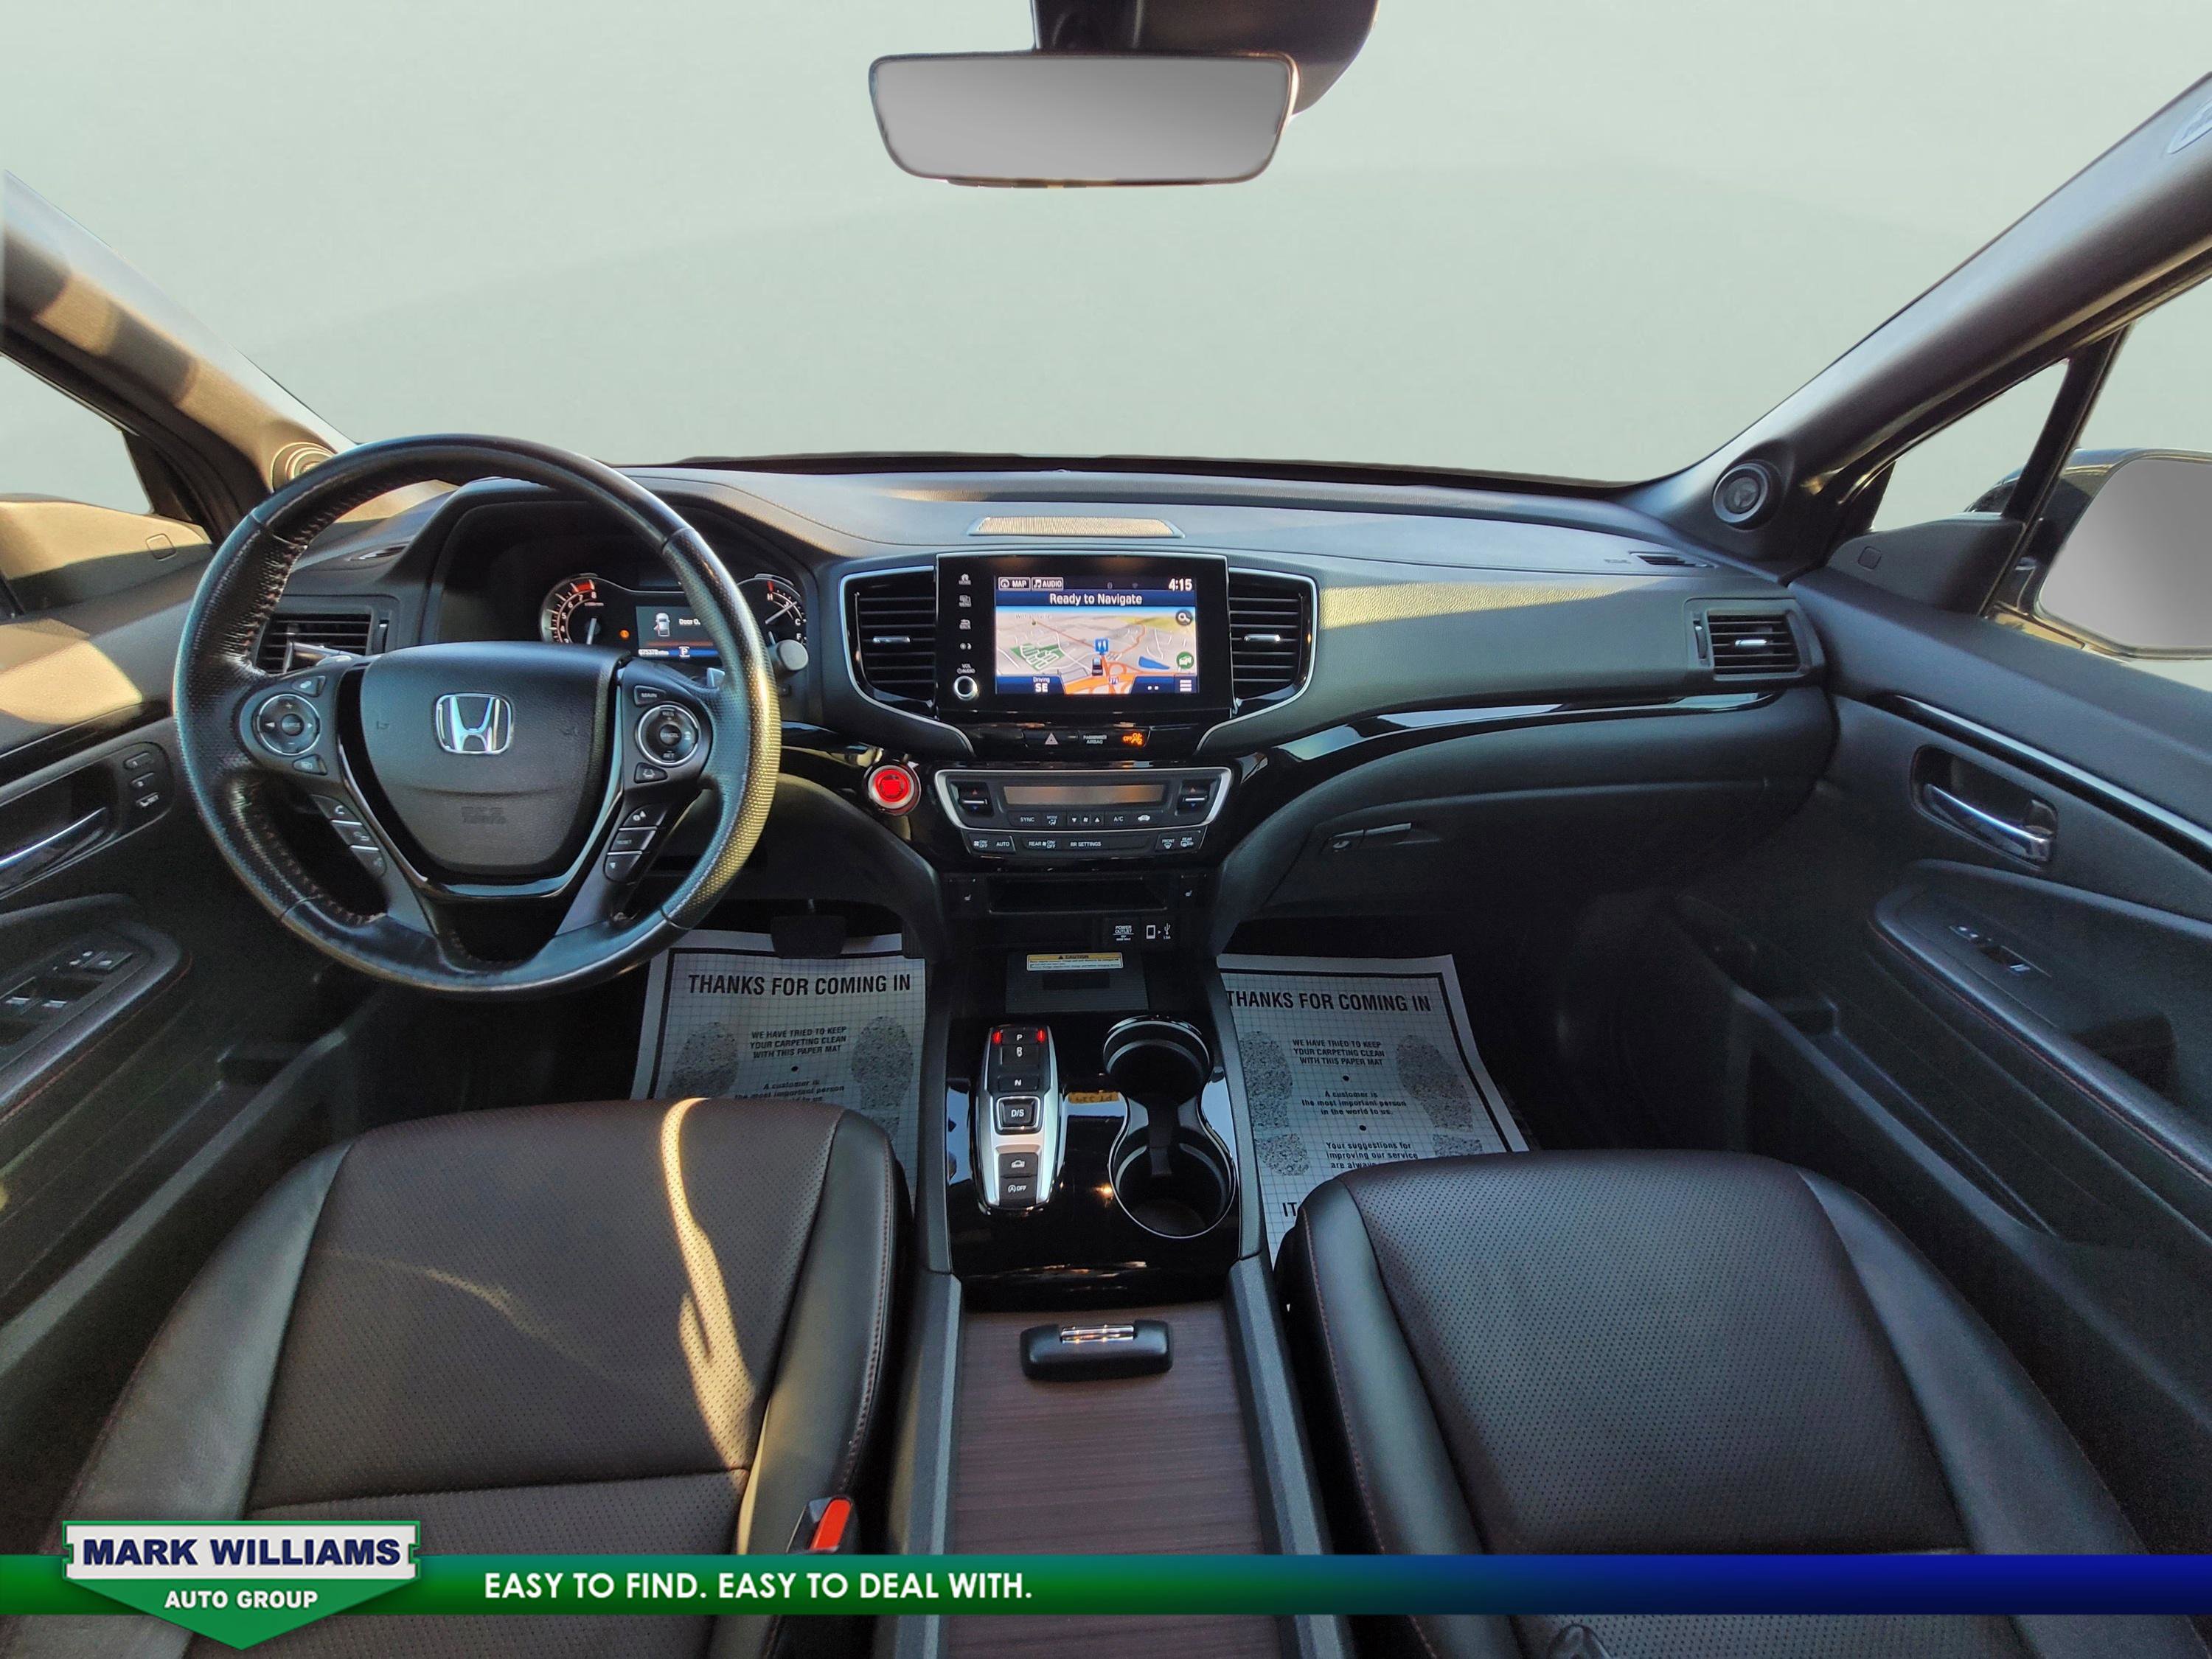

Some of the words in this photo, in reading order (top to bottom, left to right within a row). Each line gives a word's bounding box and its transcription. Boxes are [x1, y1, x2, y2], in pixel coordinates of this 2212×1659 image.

[1169, 578, 1192, 591] 4:15
[1049, 593, 1081, 606] Ready
[1084, 594, 1095, 605] to
[1098, 593, 1142, 606] Navigate
[1035, 683, 1048, 692] SE
[688, 974, 765, 995] THANKS
[771, 977, 809, 995] FOR
[815, 975, 887, 995] COMING
[894, 973, 911, 992] IN
[1227, 990, 1294, 1009] THANKS
[1298, 993, 1334, 1010] FOR
[1339, 994, 1408, 1011] COMING
[1413, 995, 1431, 1012] IN
[752, 1031, 765, 1039] WE
[766, 1030, 787, 1038] HAVE
[790, 1029, 812, 1037] TRIED
[827, 1026, 847, 1034] KEEP
[749, 1041, 772, 1049] YOUR
[774, 1037, 819, 1048] CARPETING
[821, 1035, 846, 1044] CLEAN
[1329, 1040, 1349, 1048] TRIED
[777, 1048, 795, 1057] THIS
[797, 1046, 822, 1055] PAPER
[824, 1044, 841, 1052] MAT
[1316, 1048, 1358, 1057] CARPETING
[1300, 1057, 1320, 1065] WITH
[1322, 1057, 1339, 1065] THIS
[771, 1080, 810, 1089] customer
[774, 1088, 814, 1097] important
[815, 1085, 844, 1094] person
[1338, 1099, 1377, 1107] important
[1011, 1109, 1024, 1118] D/S
[1347, 1141, 1397, 1150] suggestions
[1400, 1141, 1411, 1150] for
[1326, 1151, 1369, 1160] improving
[1387, 1152, 1418, 1160] service
[1282, 1202, 1297, 1217] IT
